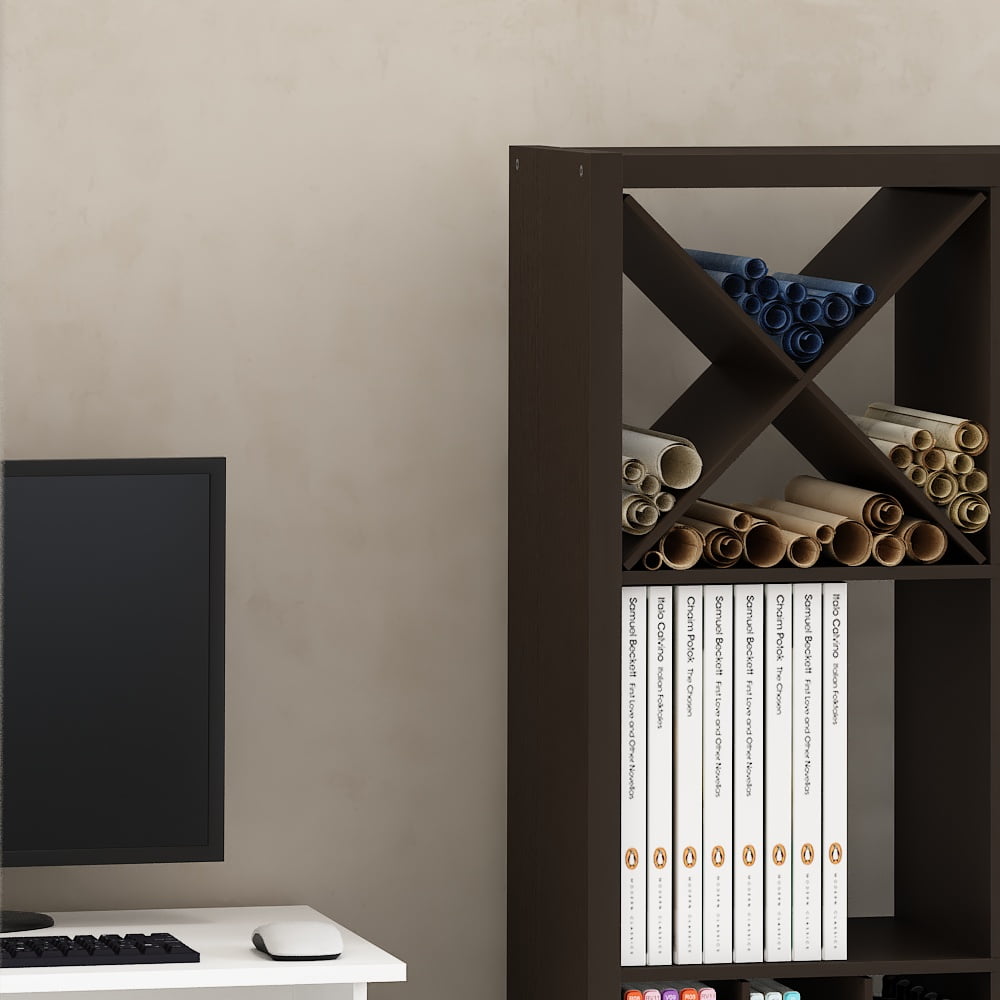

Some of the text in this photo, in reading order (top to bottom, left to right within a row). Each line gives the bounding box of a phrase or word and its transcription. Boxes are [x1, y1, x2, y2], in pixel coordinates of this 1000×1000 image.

[629, 597, 638, 637] Samuel
[657, 597, 666, 620] Italo
[687, 596, 695, 632] Chaim
[715, 596, 724, 635] Samuel
[746, 595, 755, 634] Samuel
[776, 594, 785, 630] Chaim
[804, 593, 813, 633] Samuel
[832, 594, 841, 616] Italo
[657, 622, 666, 662] Calvino
[687, 634, 695, 663] Potok
[715, 638, 724, 675] Beckett
[746, 637, 755, 675] Beckett
[776, 633, 785, 661] Potok
[804, 636, 813, 674] Beckett
[832, 618, 841, 658] Calvino
[629, 639, 638, 677] Beckett
